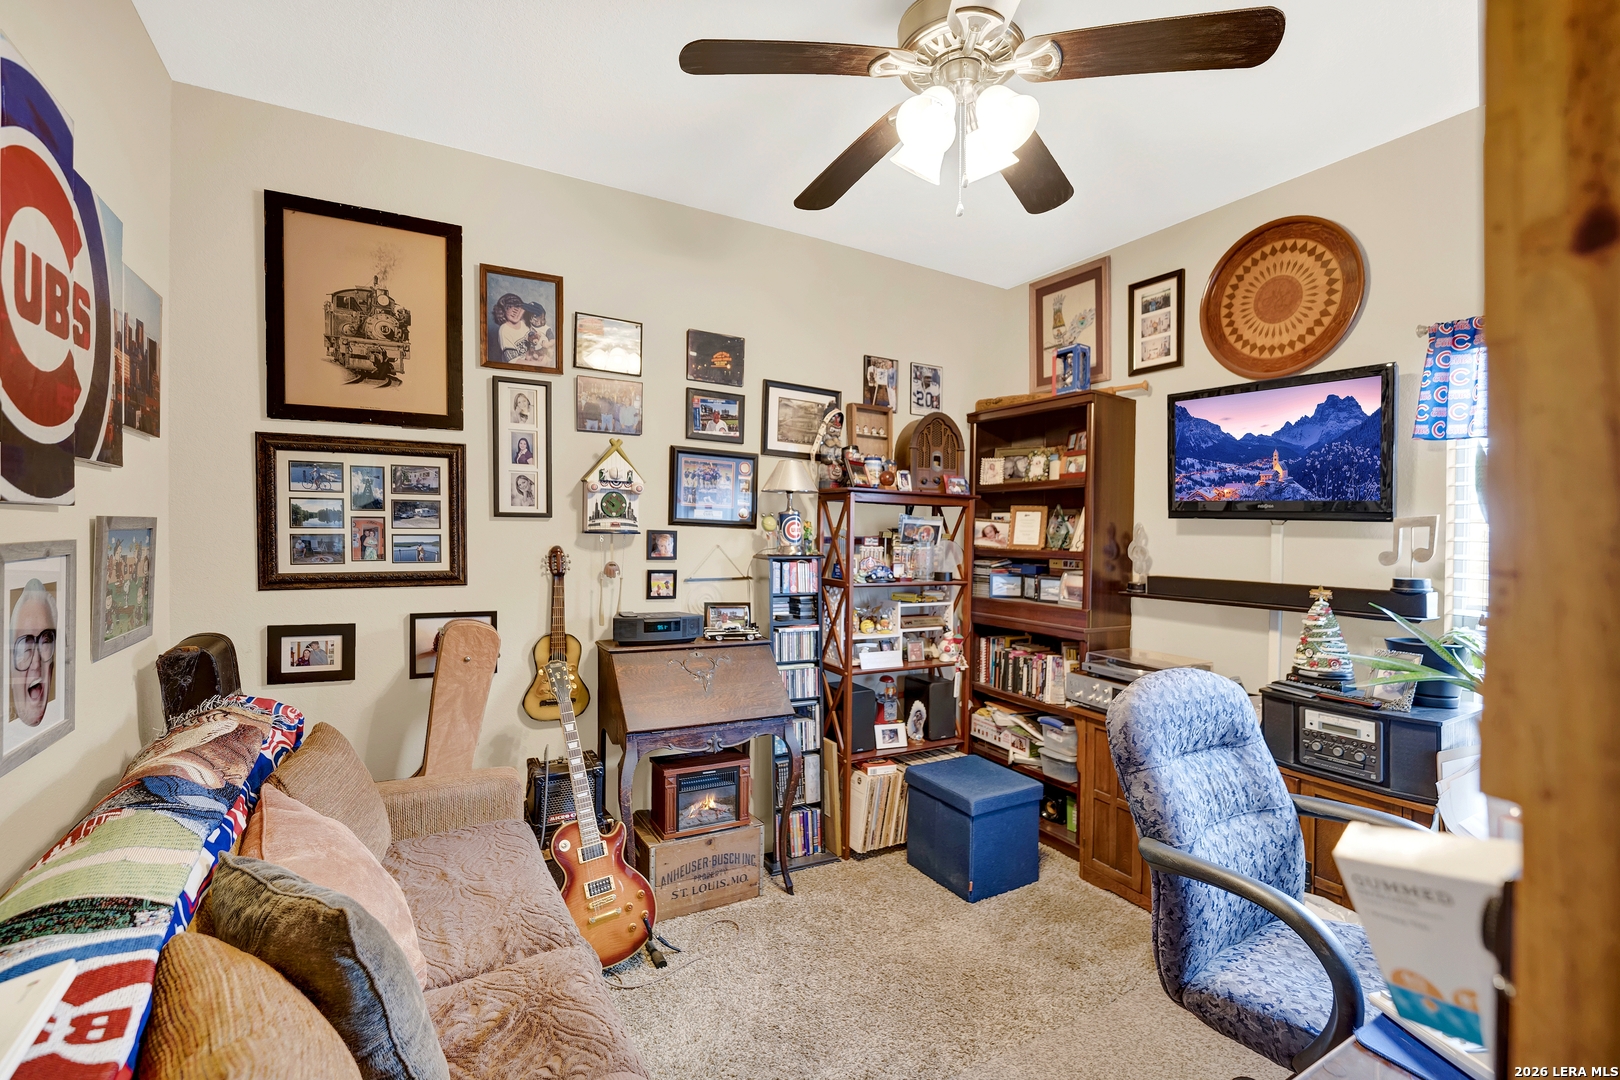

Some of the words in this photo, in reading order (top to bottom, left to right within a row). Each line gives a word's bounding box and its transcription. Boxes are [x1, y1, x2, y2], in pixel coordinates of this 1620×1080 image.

[1451, 334, 1471, 351] C
[1450, 368, 1470, 386] C
[1448, 402, 1468, 421] C
[660, 852, 741, 889] ANHEUSER-BUSCH
[671, 888, 689, 900] ST.
